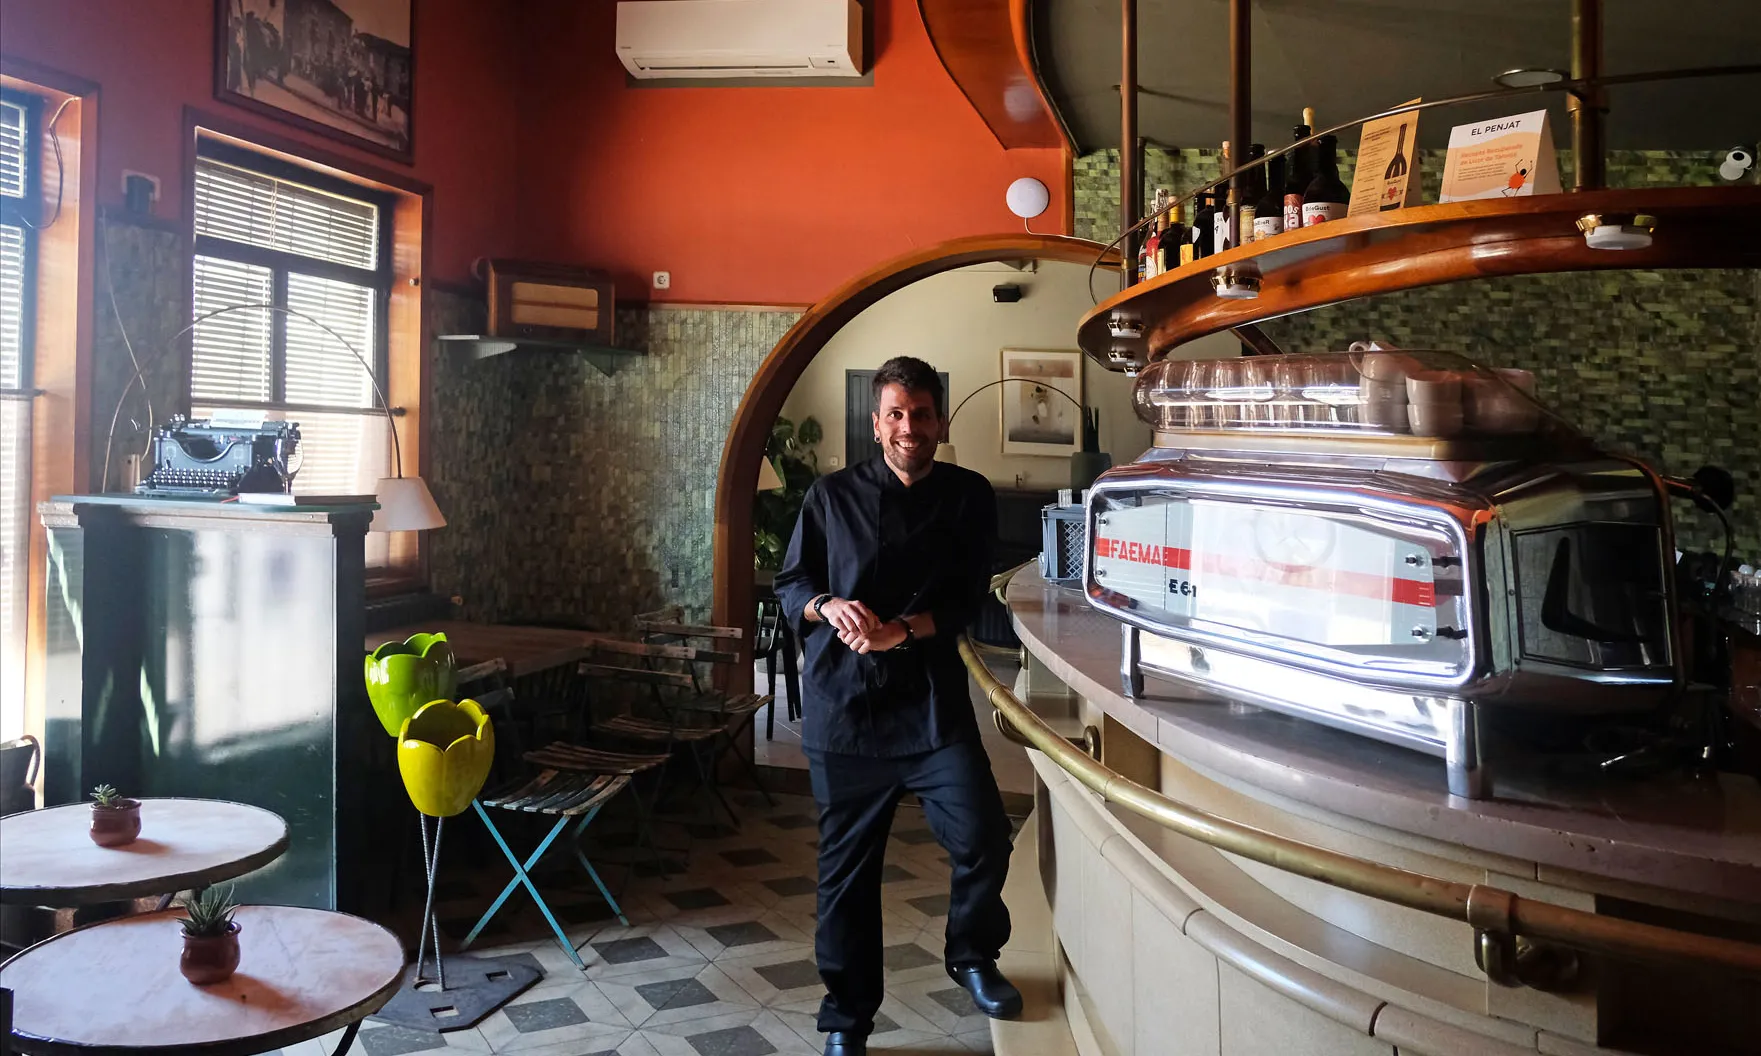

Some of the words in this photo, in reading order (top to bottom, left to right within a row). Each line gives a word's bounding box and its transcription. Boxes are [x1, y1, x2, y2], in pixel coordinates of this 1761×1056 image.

[1471, 128, 1482, 136] EL
[1485, 120, 1521, 133] PENJAT
[1110, 539, 1162, 565] FAEMA
